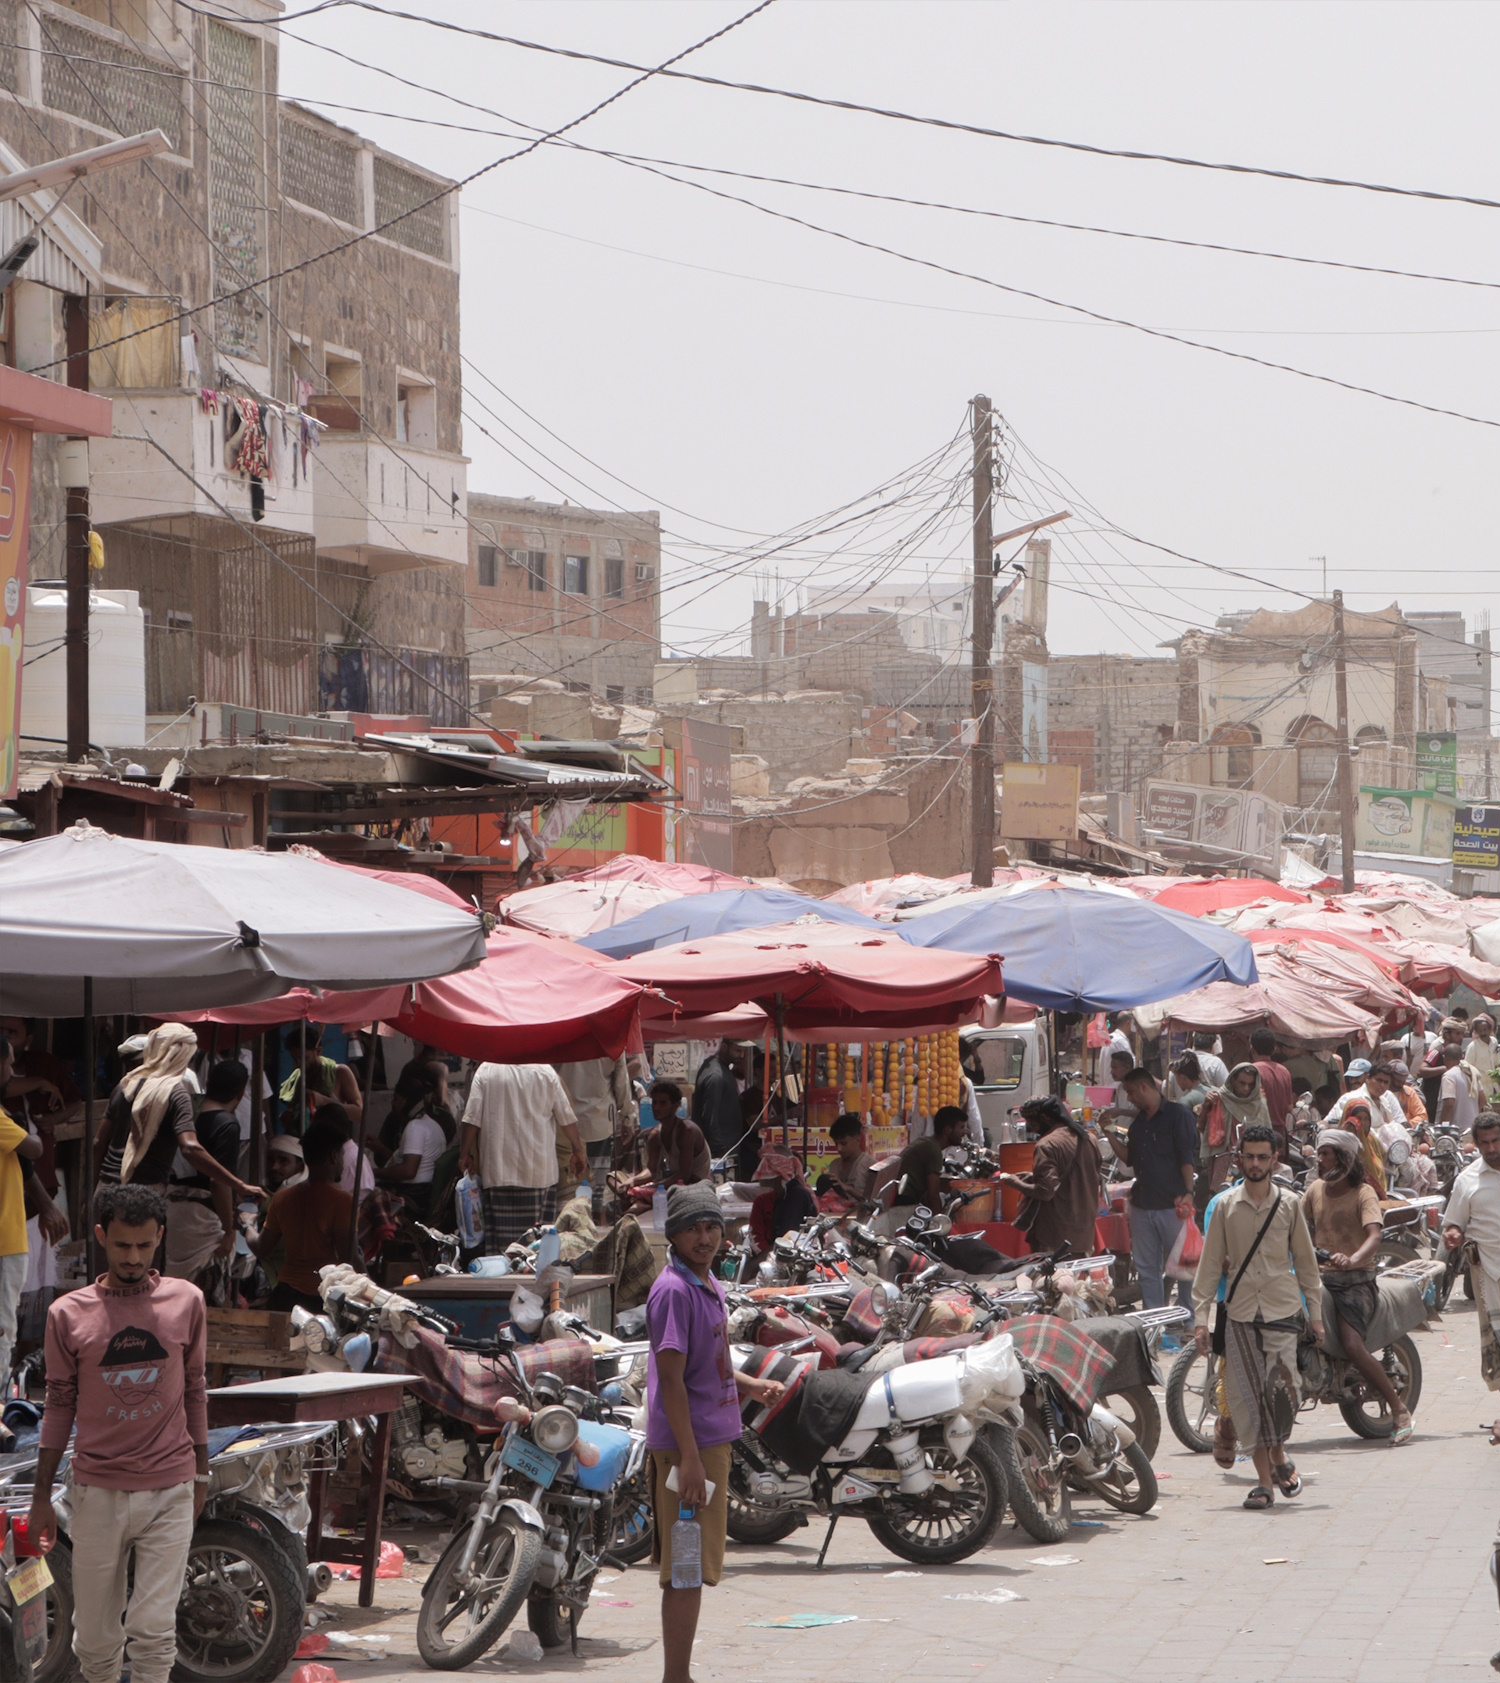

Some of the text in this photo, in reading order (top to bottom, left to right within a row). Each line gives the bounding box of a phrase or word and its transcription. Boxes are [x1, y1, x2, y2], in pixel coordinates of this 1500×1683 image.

[1454, 821, 1500, 838] صيدلية
[1453, 838, 1499, 851] بيت الصحة
[104, 1284, 150, 1297] FRESH
[106, 1399, 163, 1420] FRESH
[516, 1458, 539, 1476] 286
